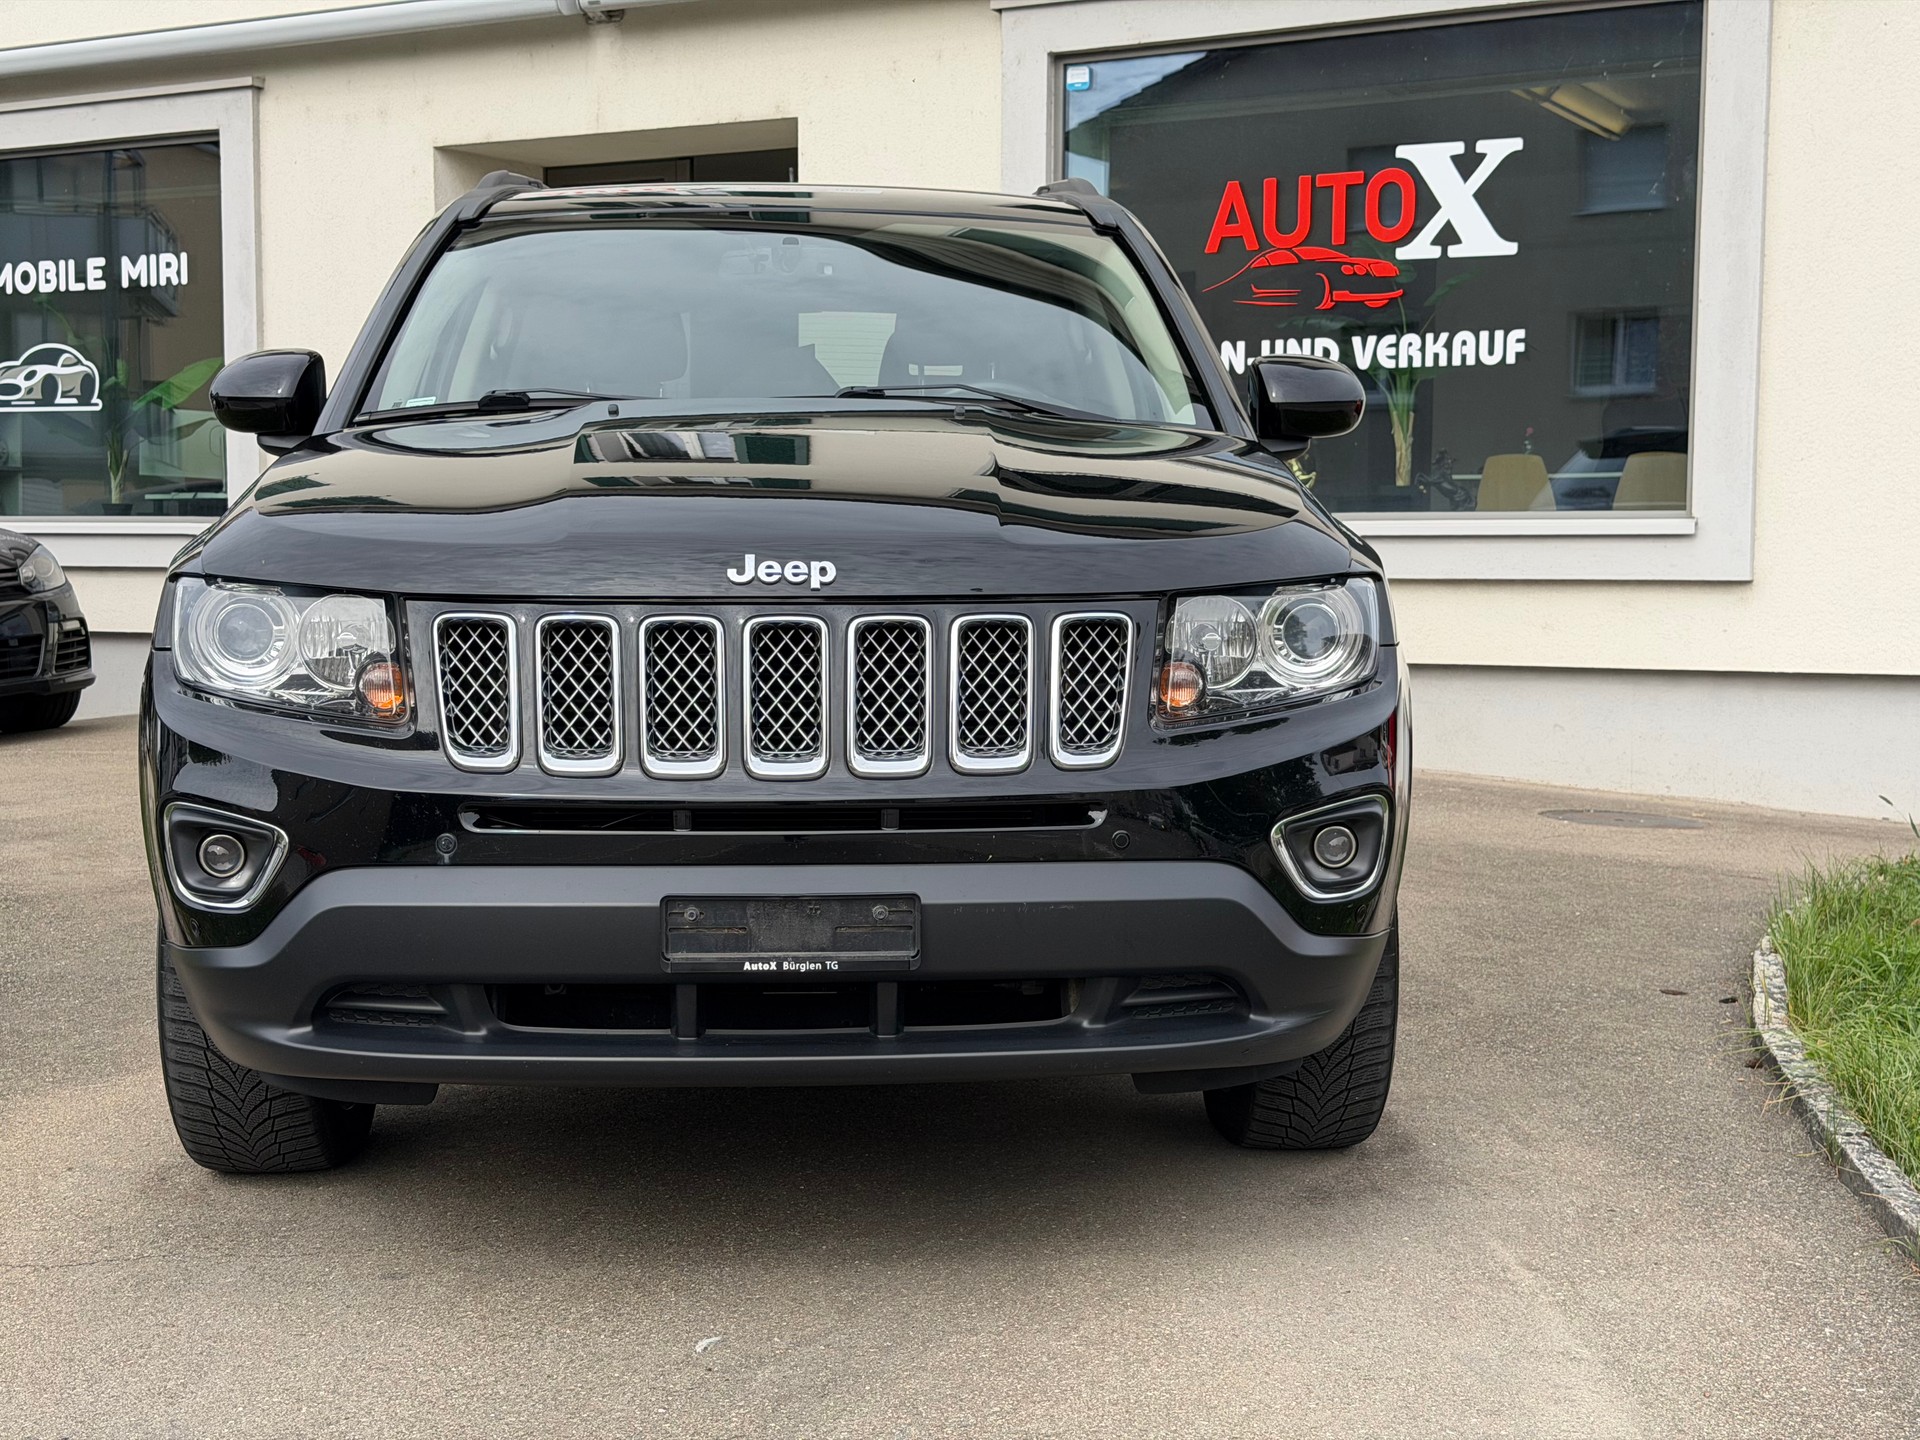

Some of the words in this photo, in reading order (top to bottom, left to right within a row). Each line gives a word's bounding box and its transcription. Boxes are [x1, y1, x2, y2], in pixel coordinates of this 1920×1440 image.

[120, 251, 189, 289] MIRI
[1351, 328, 1526, 371] VERKAUF
[726, 553, 837, 590] Jeep
[743, 961, 778, 971] AutoX
[782, 960, 823, 973] Bürglen
[824, 960, 839, 971] TG
